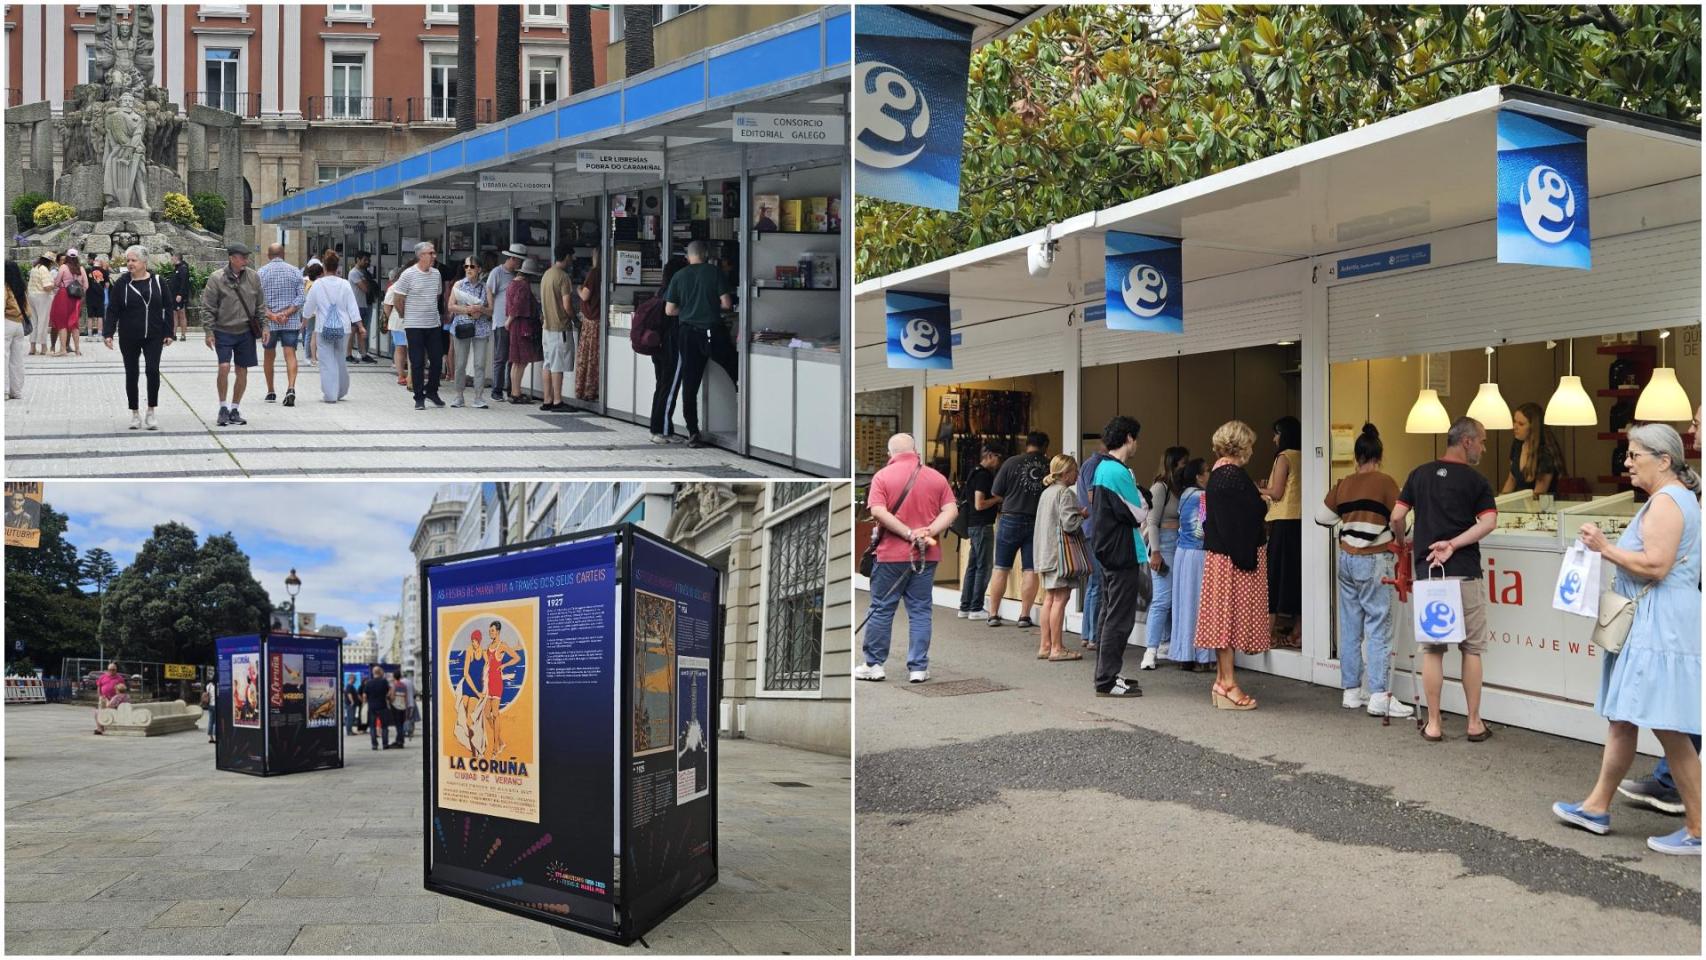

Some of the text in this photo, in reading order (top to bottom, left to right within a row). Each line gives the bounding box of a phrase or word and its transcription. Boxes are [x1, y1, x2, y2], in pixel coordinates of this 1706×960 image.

[773, 118, 823, 127] CONSORCIO
[741, 129, 826, 140] EDITORIAL GALEGO
[1684, 343, 1699, 356] DE
[576, 568, 606, 584] CARTEIS
[1488, 558, 1523, 606] ia
[547, 598, 563, 607] 1927
[449, 756, 529, 776] LA CORUÑA
[481, 774, 490, 782] DE
[495, 775, 523, 786] VERANO
